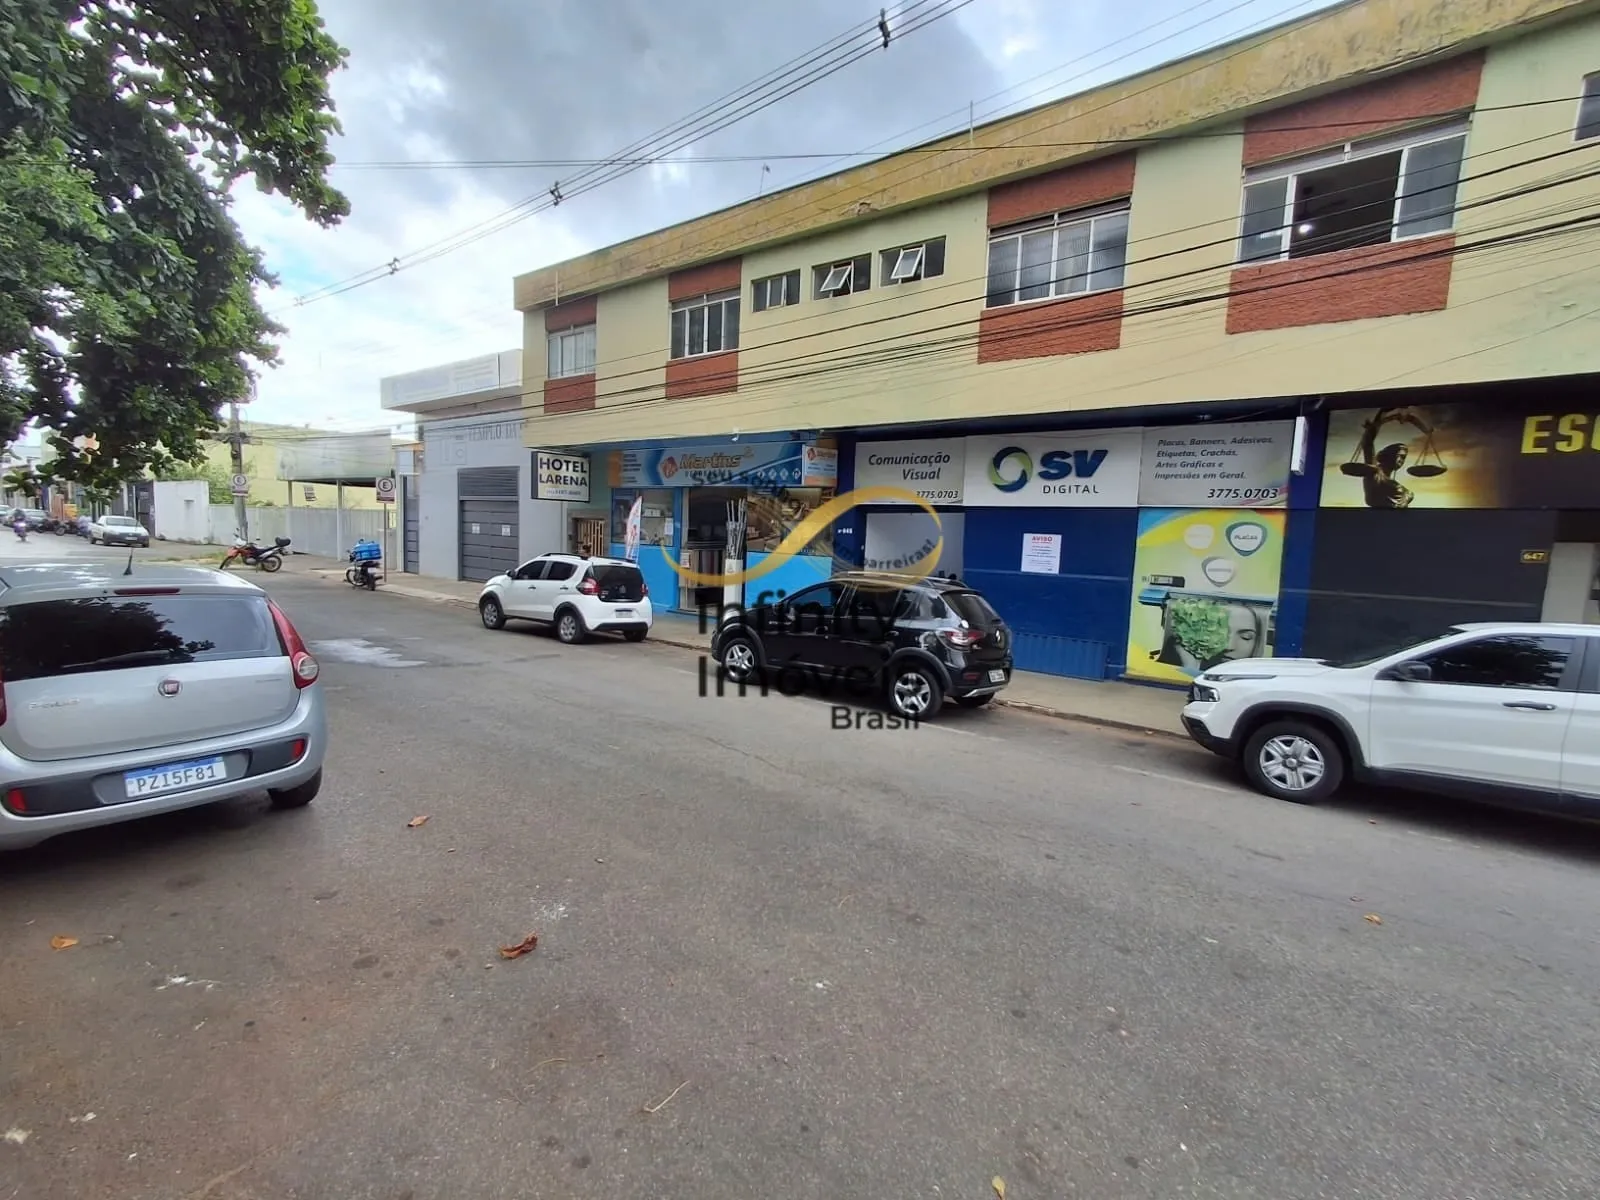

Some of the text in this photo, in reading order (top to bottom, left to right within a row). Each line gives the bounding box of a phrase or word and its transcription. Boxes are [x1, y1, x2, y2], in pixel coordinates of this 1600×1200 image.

[1189, 438, 1226, 446] Banners,
[539, 457, 588, 474] HOTEL
[868, 451, 951, 467] Comunicação
[1038, 449, 1109, 481] SV
[902, 467, 942, 480] Visual
[539, 474, 588, 487] LARENA
[1042, 484, 1100, 494] DIGITAL
[1207, 488, 1278, 499] 3775.0703
[1523, 552, 1545, 560] 647
[136, 765, 217, 793] PZI5F81
